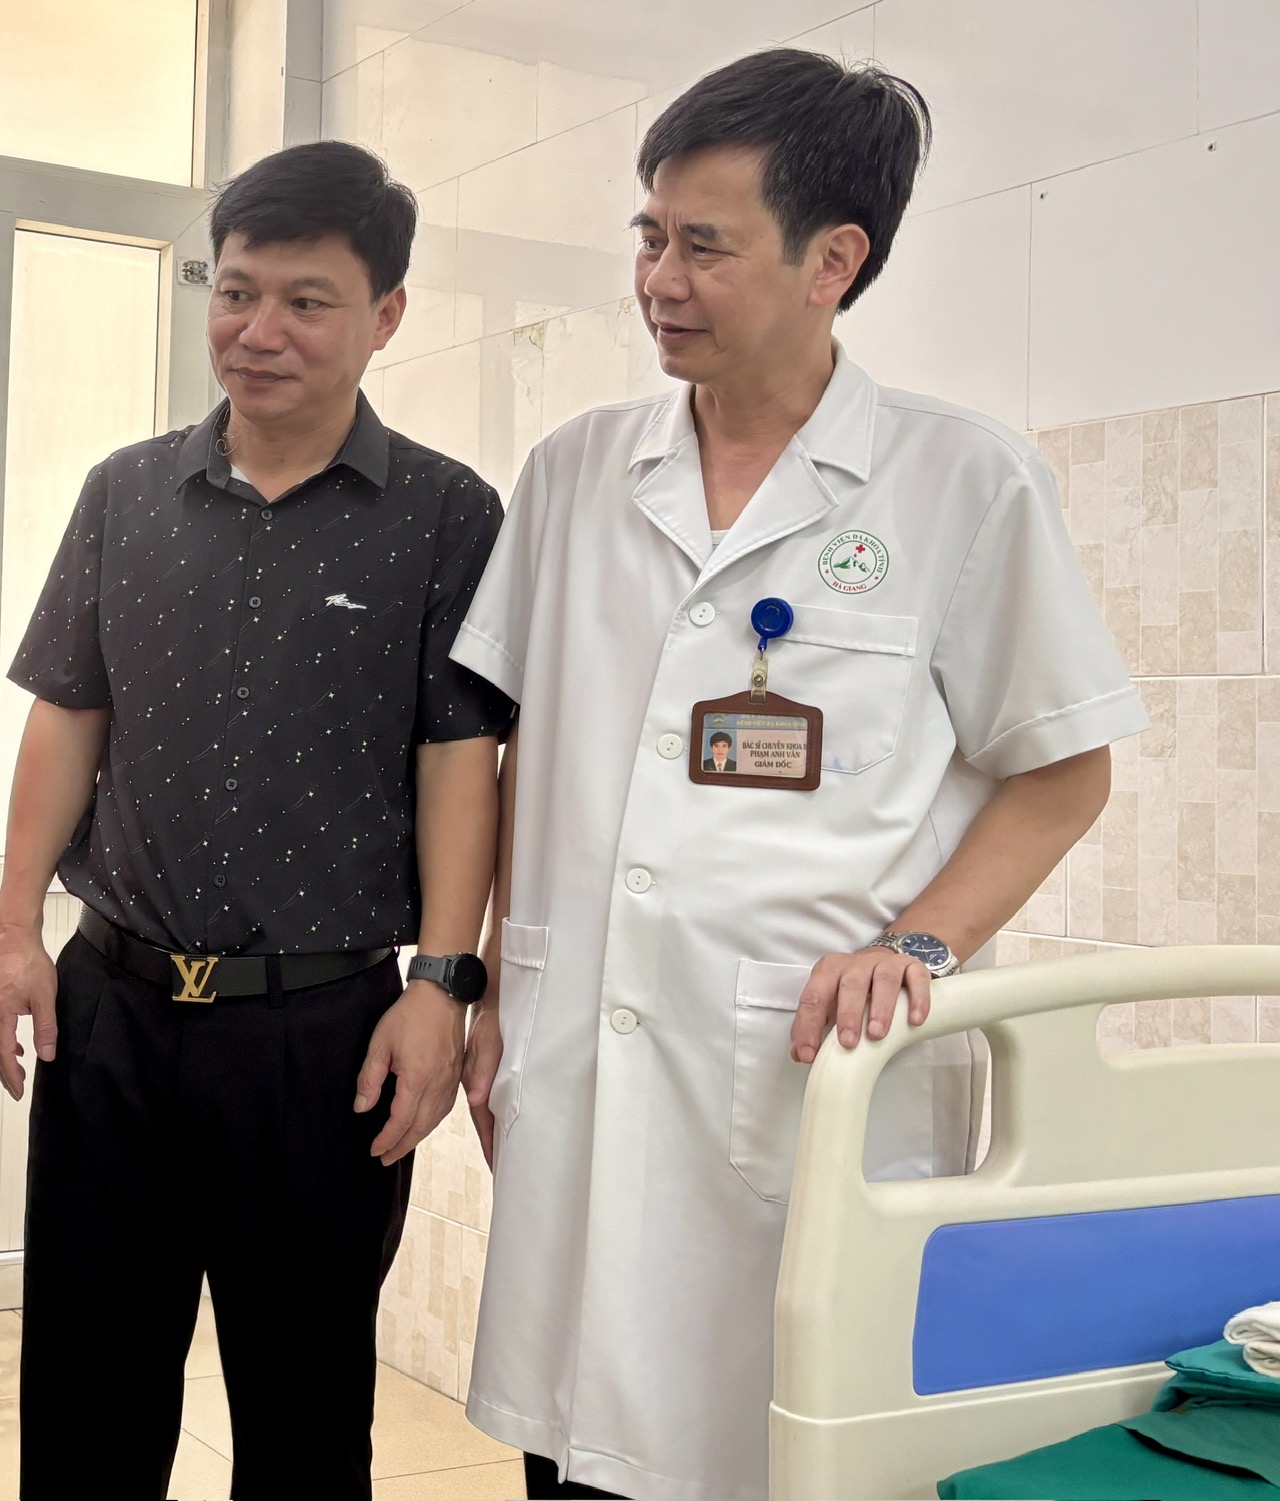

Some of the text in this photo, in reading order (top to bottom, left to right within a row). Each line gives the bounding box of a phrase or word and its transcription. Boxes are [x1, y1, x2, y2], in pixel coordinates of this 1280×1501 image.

[863, 537, 882, 554] KHOA
[843, 583, 867, 592] GIANG
[786, 742, 802, 751] KHOA
[750, 750, 770, 759] PHẠM
[754, 759, 774, 768] GIÁM
